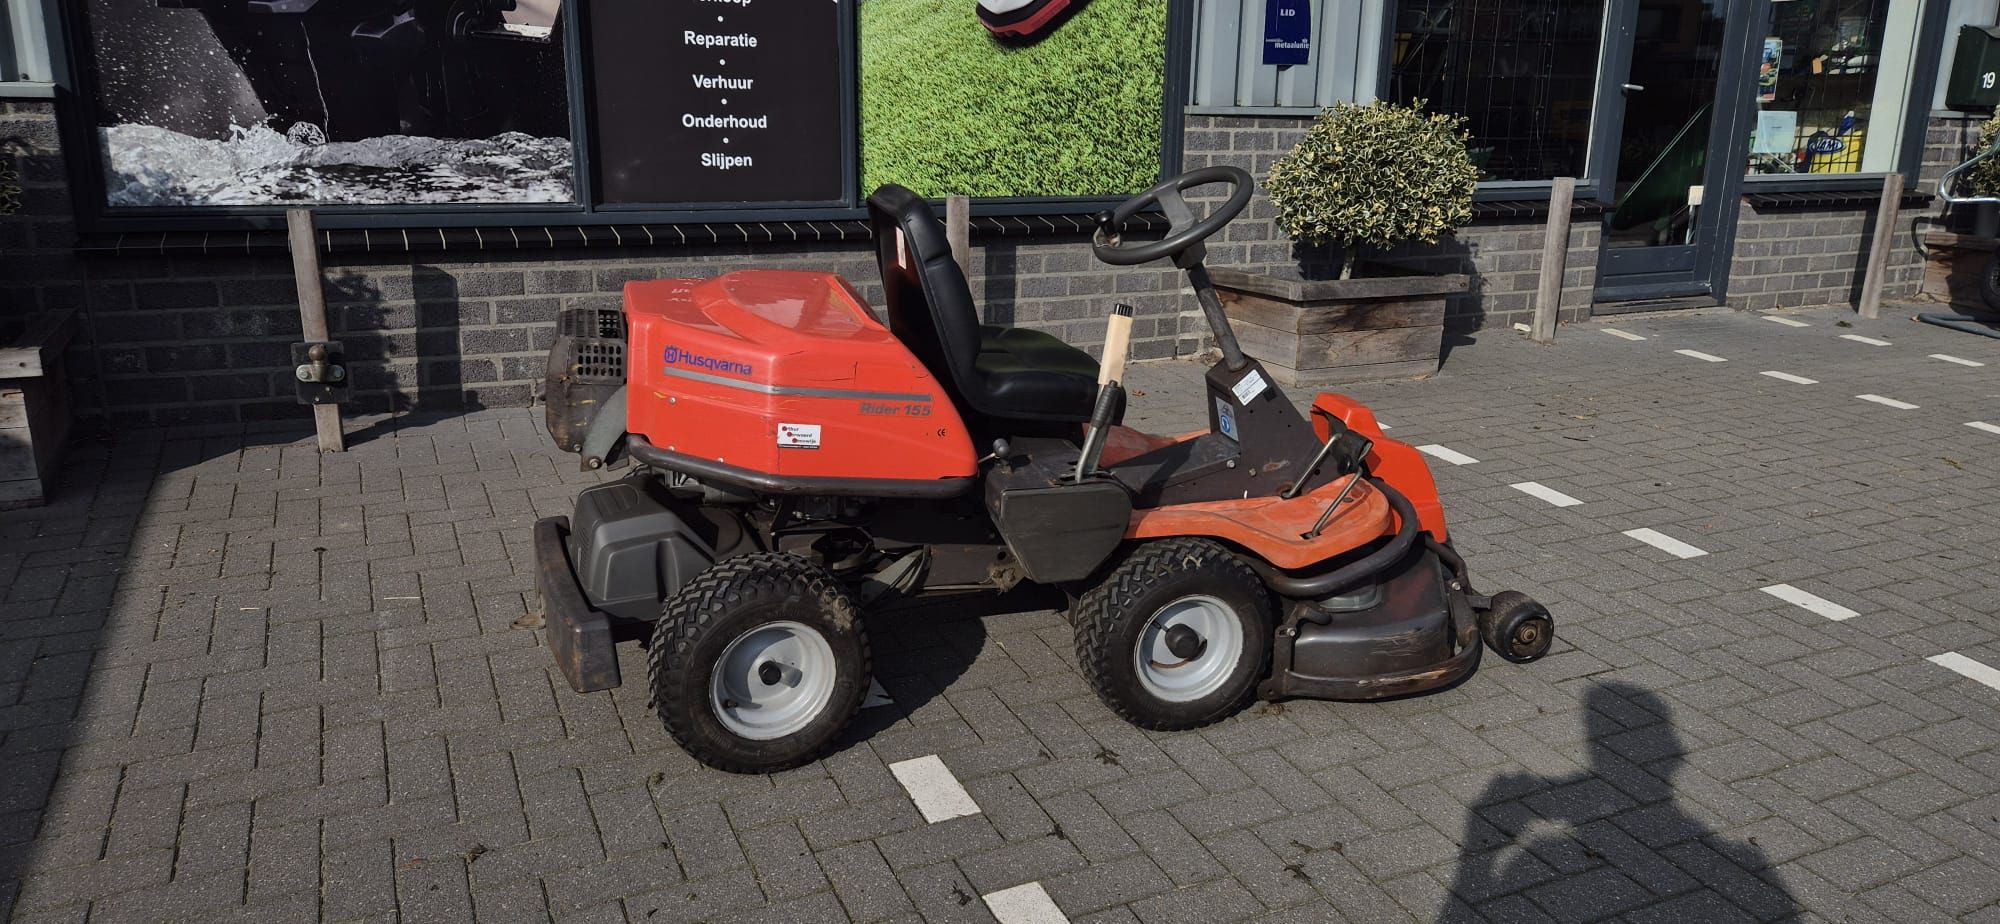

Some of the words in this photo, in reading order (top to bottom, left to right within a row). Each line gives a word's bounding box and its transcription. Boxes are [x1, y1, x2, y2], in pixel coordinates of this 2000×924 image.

[684, 31, 757, 48] Reparatie
[692, 74, 754, 90] Verhuur
[1982, 71, 1996, 89] 19
[682, 113, 767, 129] Onderhoud
[701, 153, 753, 170] Slijpen
[678, 349, 752, 375] Husqvarna
[860, 402, 900, 414] Rider
[904, 404, 932, 417] 155
